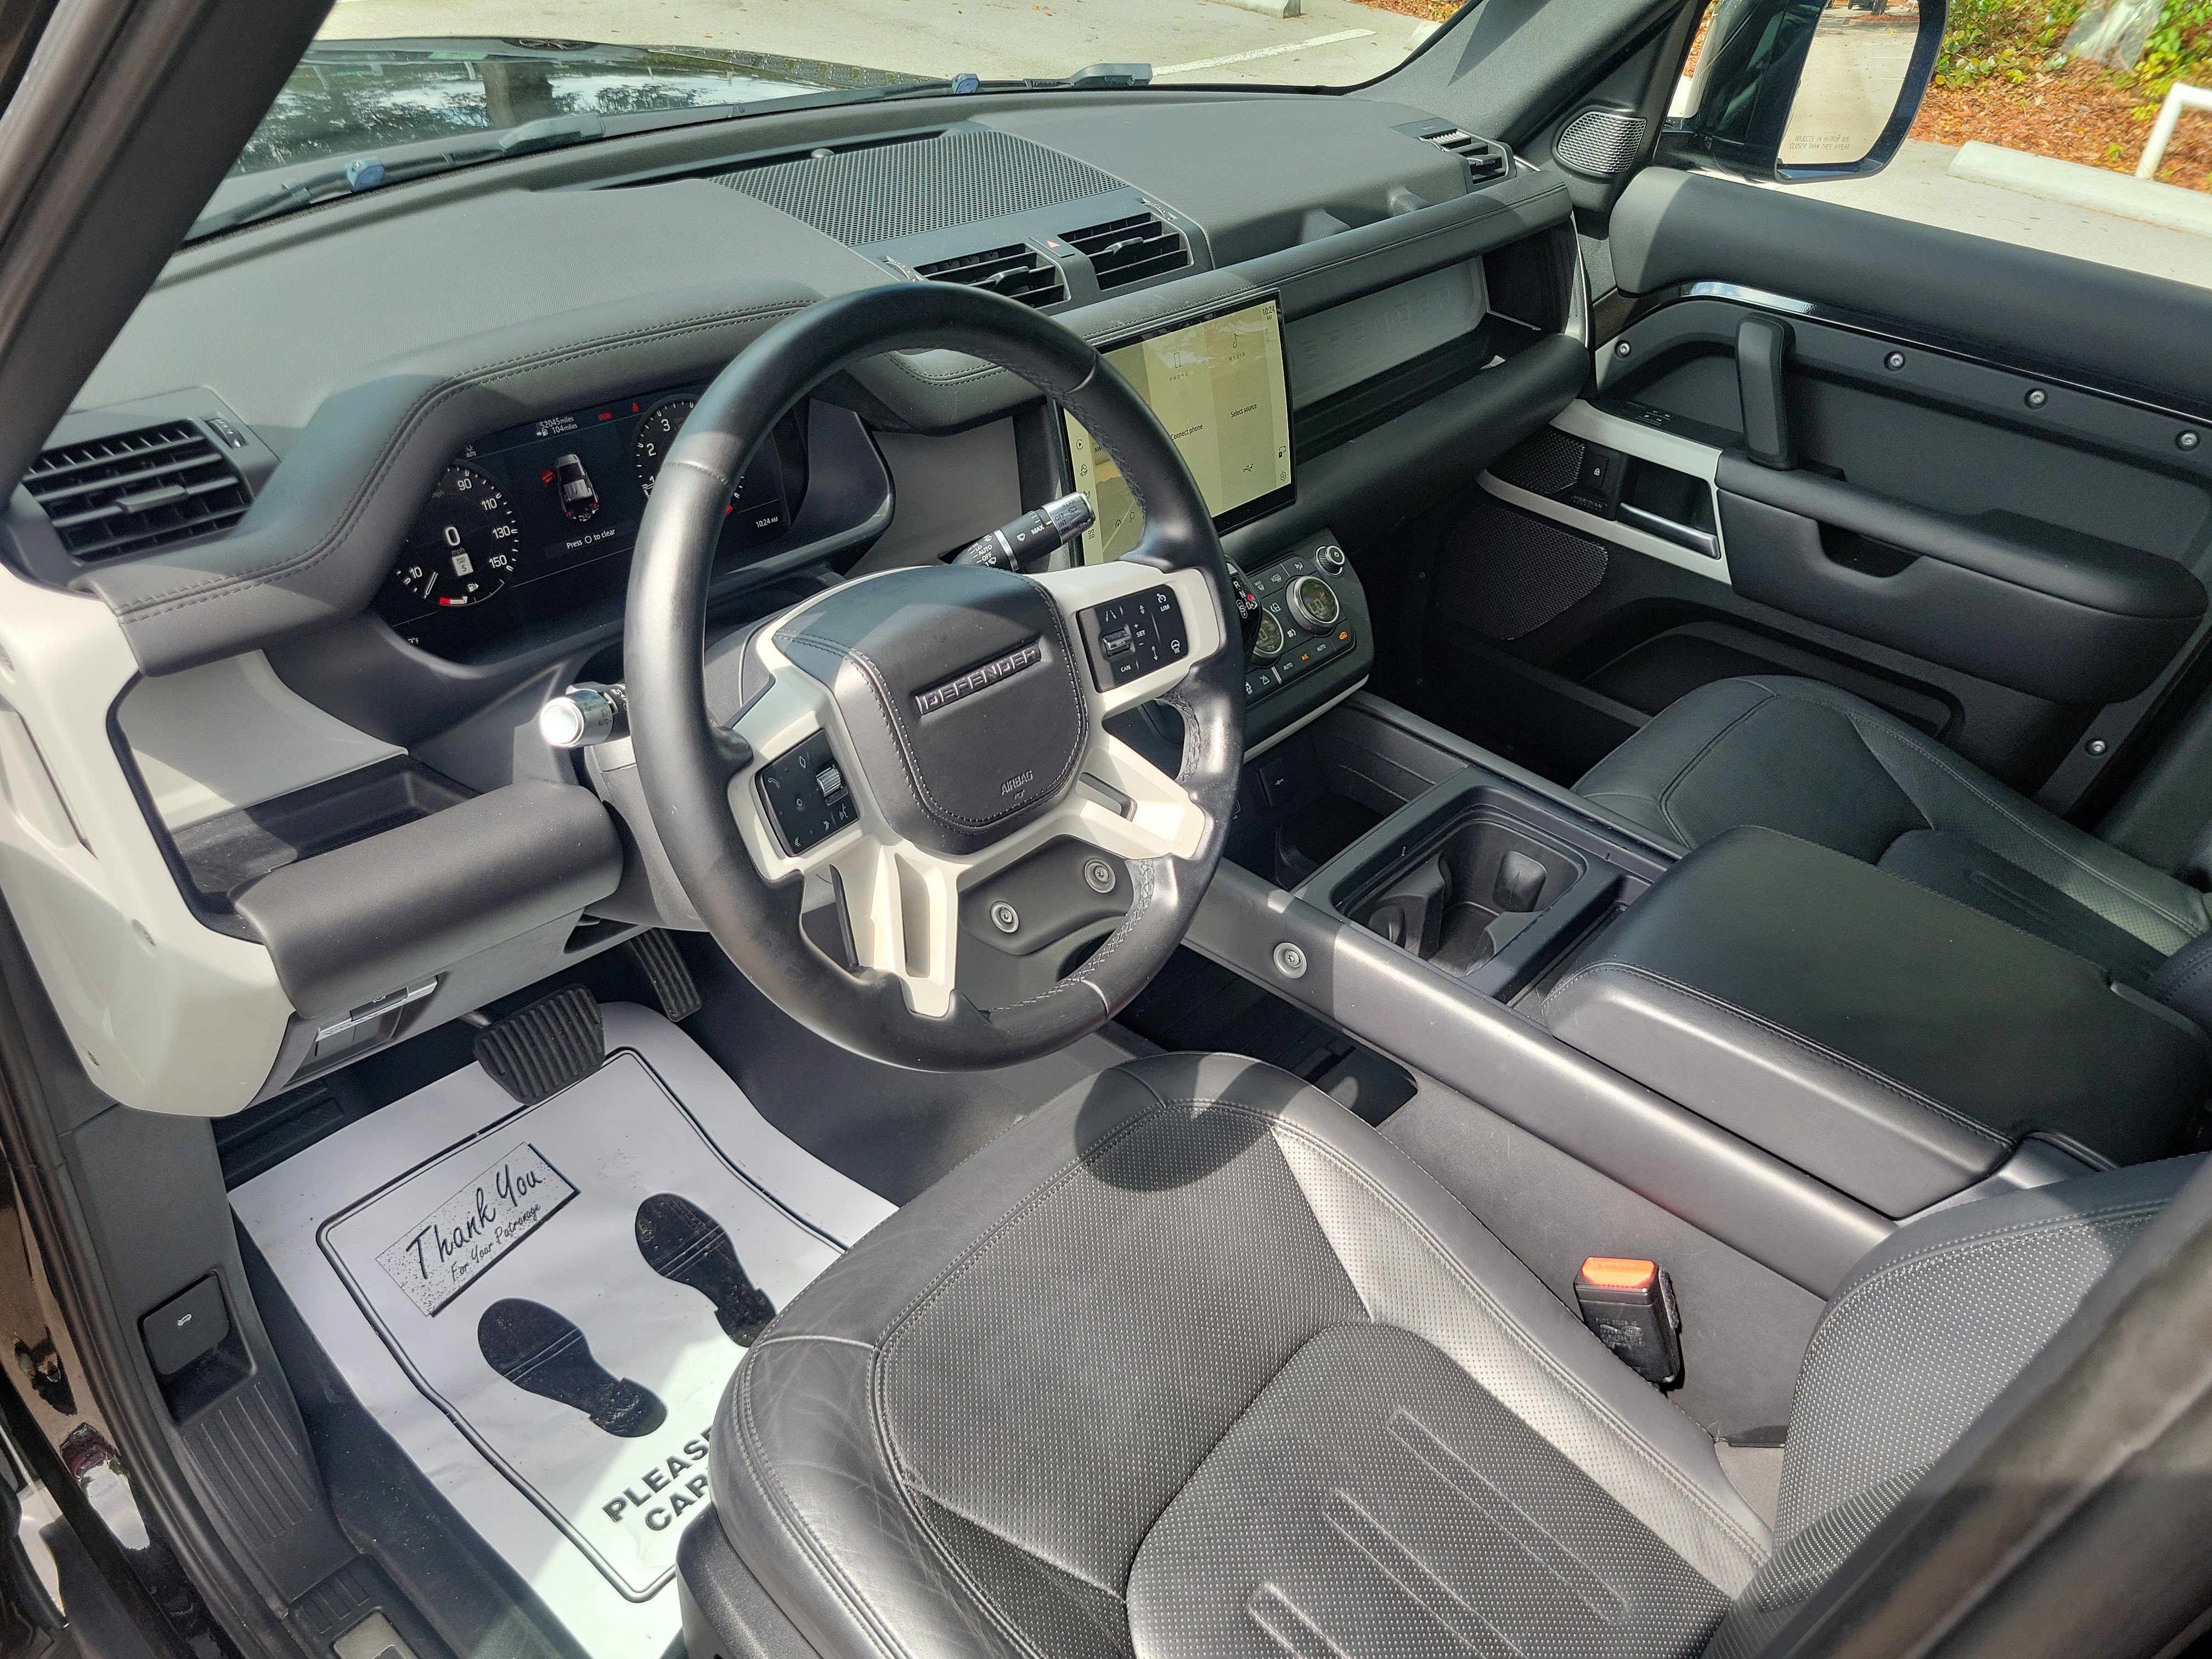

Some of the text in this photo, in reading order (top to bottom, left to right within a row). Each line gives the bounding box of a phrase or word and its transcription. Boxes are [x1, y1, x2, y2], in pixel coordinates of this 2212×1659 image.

[1262, 305, 1275, 315] 10:24
[1169, 371, 1188, 381] PHONE
[1231, 404, 1257, 418] Select source
[661, 419, 670, 432] 3
[1170, 424, 1203, 441] Connect phone
[646, 443, 657, 456] 2
[457, 478, 472, 491] 90
[481, 498, 498, 511] 110
[1062, 499, 1075, 508] REAR
[755, 517, 771, 528] 10:24
[1055, 512, 1064, 521] OFF
[1031, 524, 1045, 535] MAX
[1058, 519, 1067, 528] INT
[445, 527, 461, 546] 0
[493, 525, 511, 539] 130
[566, 540, 583, 549] Press
[601, 529, 615, 538] clear
[452, 547, 465, 556] mph
[978, 544, 992, 556] AUTO
[489, 555, 507, 569] 150
[982, 552, 992, 562] OFF
[410, 567, 423, 579] 10
[1233, 580, 1241, 589] R
[1239, 590, 1246, 599] N
[1136, 629, 1146, 637] SET
[1317, 644, 1327, 652] AUTO
[1120, 664, 1131, 673] CAN
[1283, 662, 1293, 670] AUTO
[922, 647, 1036, 710] DEFENDER
[1001, 769, 1033, 795] AIRBAG
[405, 1163, 543, 1280] Thank You
[452, 1204, 541, 1282] For Your Patronage
